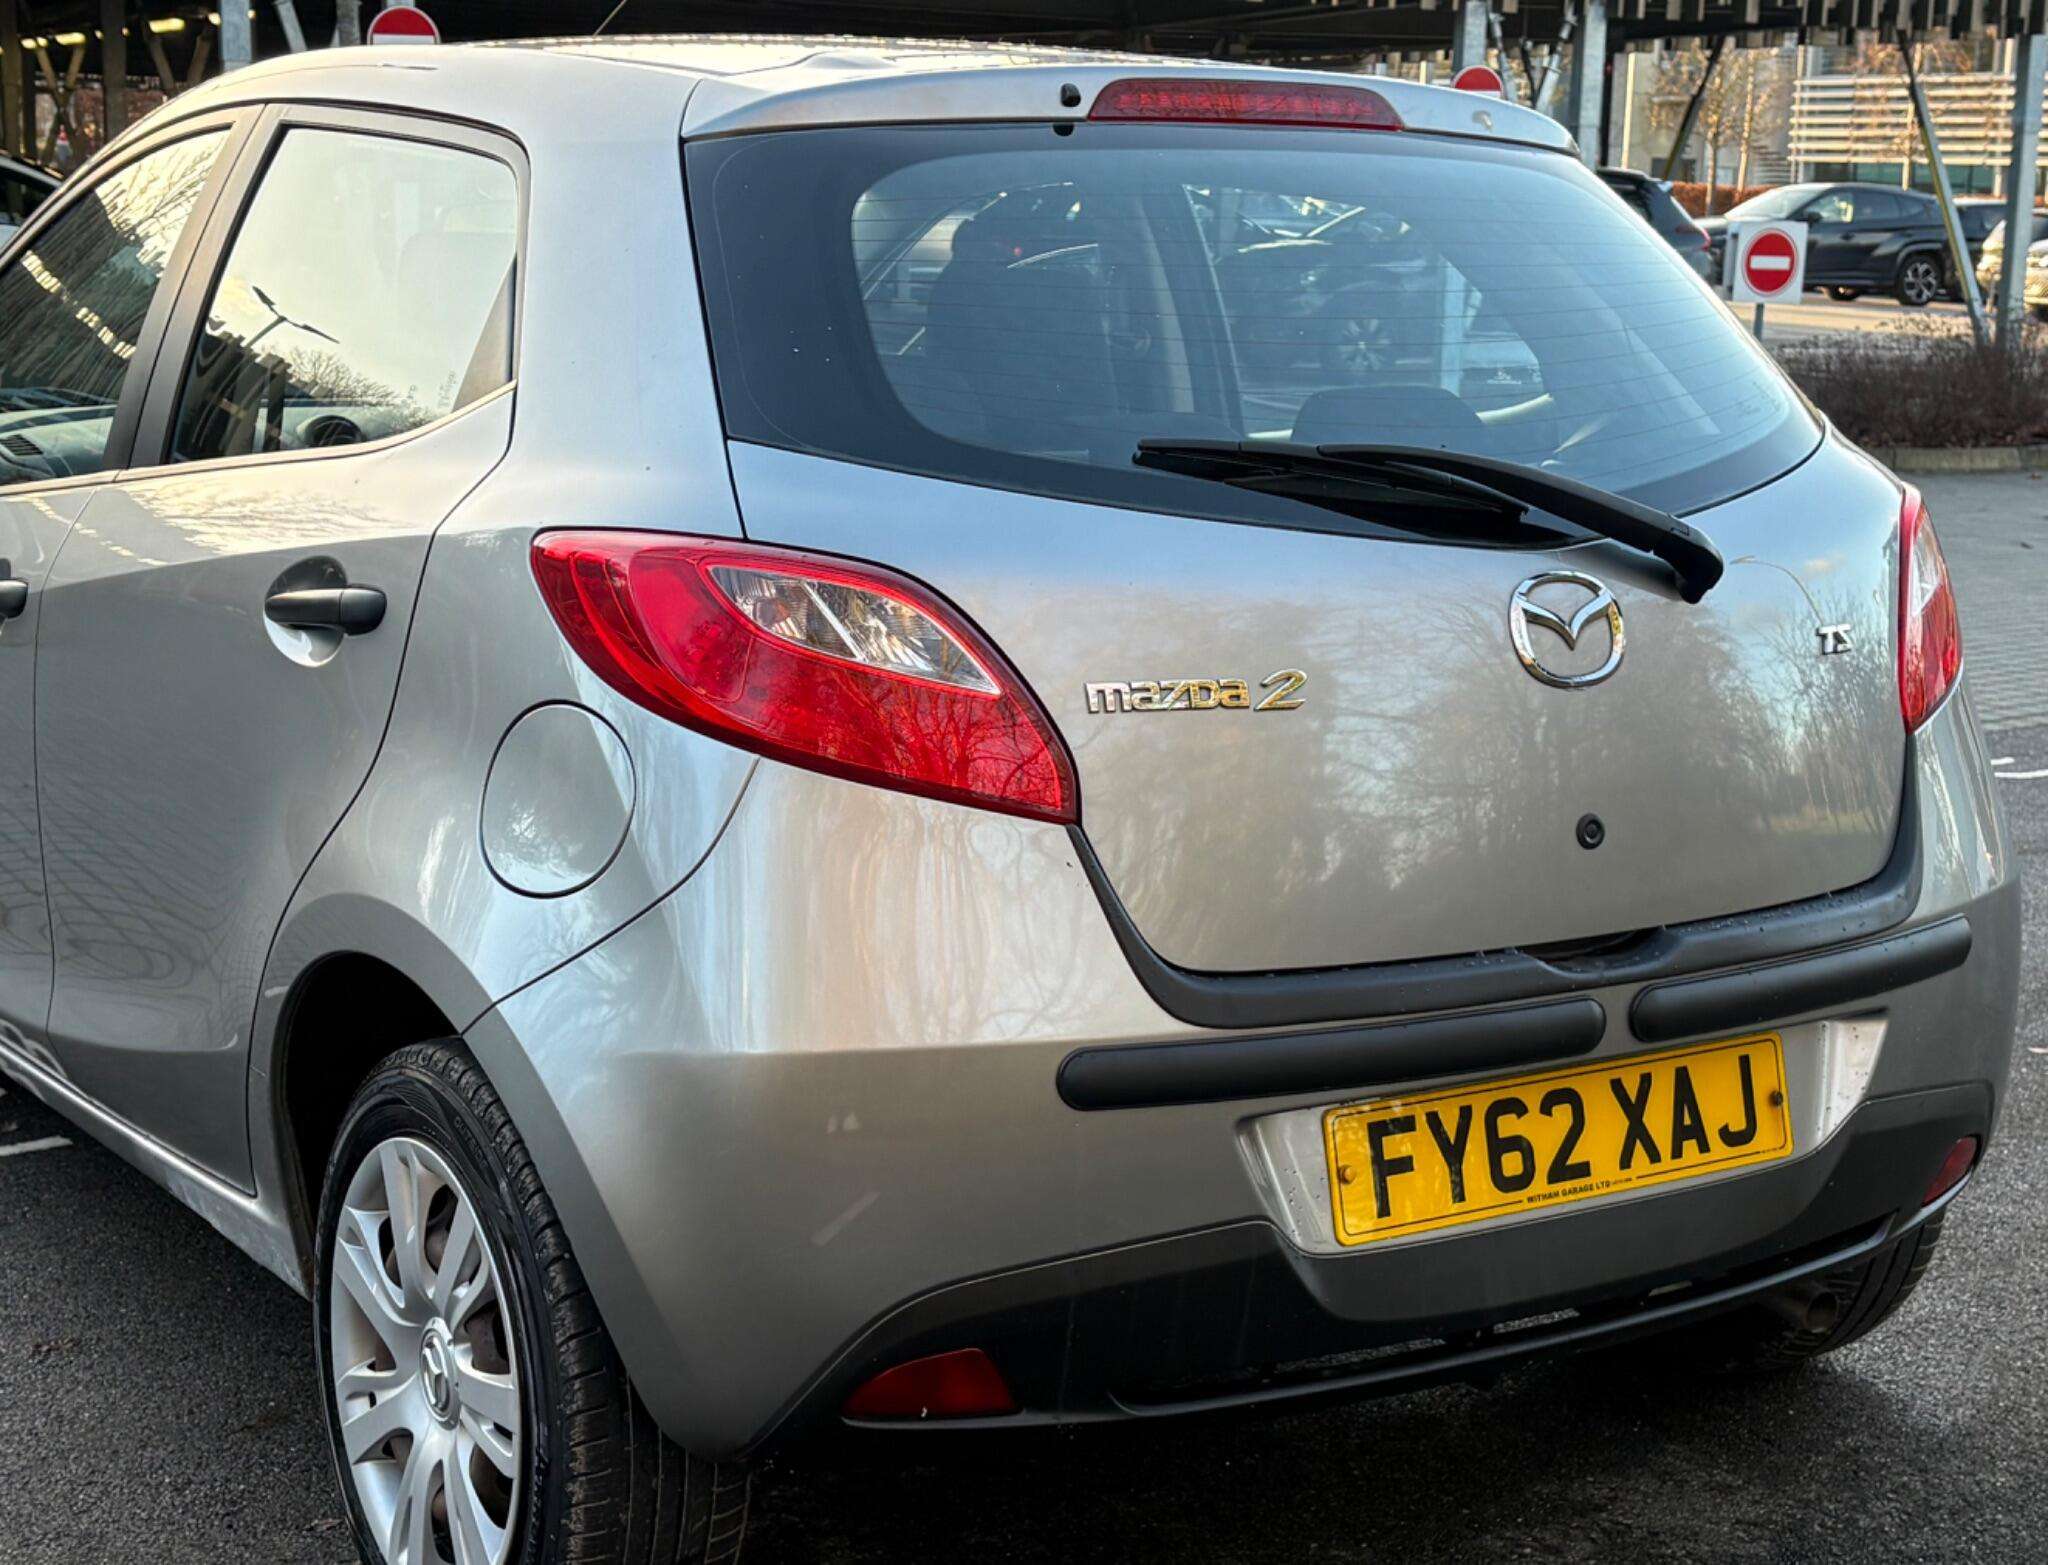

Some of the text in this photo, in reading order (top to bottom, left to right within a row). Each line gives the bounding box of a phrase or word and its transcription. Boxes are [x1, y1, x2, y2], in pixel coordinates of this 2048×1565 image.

[1816, 623, 1853, 655] TS
[1253, 668, 1308, 712] 2
[1366, 1053, 1758, 1219] FY62 XAJ
[1561, 1184, 1594, 1197] GARAGE
[1595, 1180, 1611, 1191] LTD
